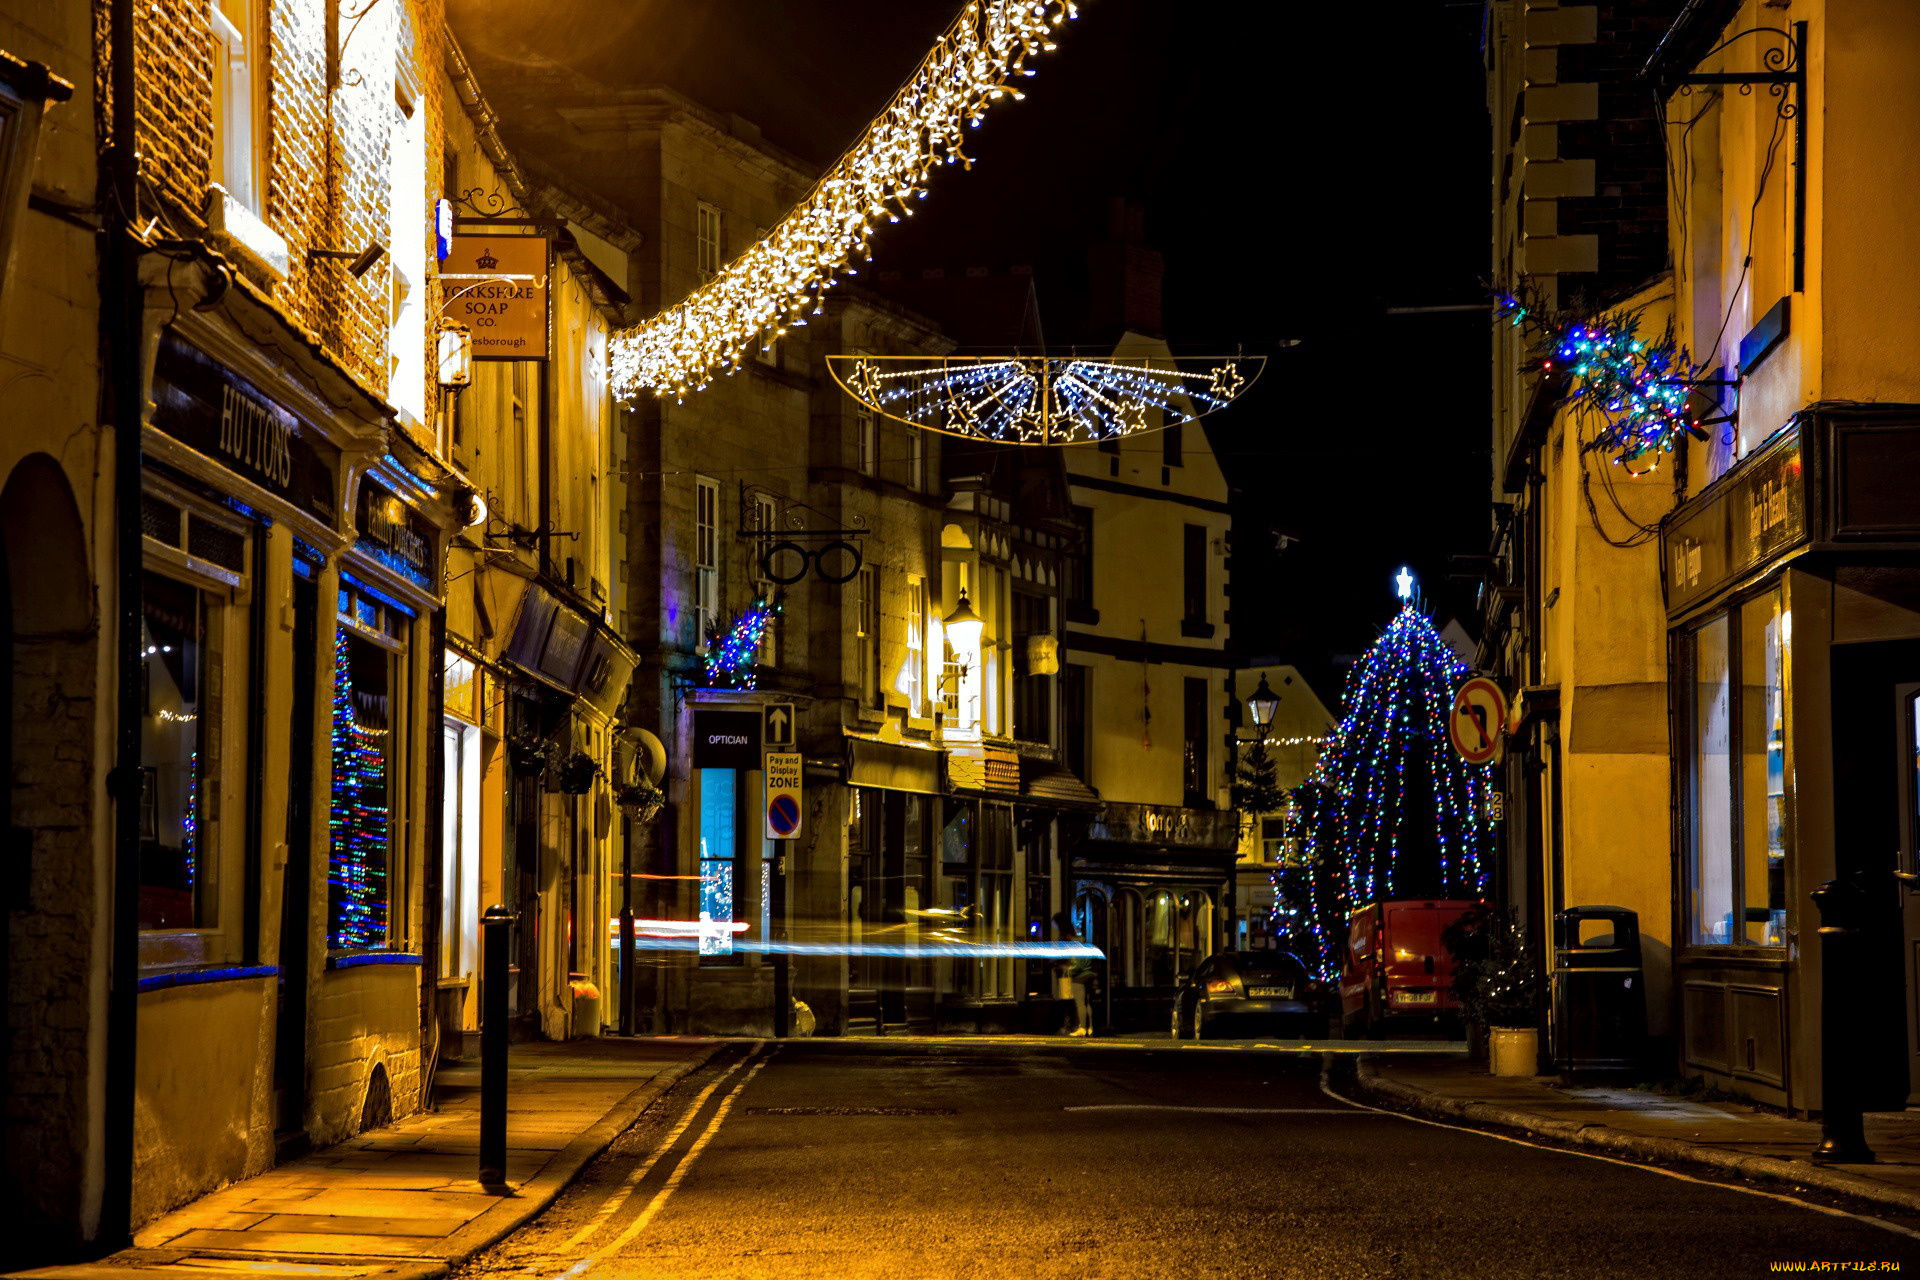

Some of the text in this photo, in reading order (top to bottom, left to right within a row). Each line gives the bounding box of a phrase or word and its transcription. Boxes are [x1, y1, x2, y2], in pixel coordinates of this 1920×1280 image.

[442, 286, 534, 299] YORKSHIRE
[465, 302, 509, 314] SOAP
[476, 318, 497, 327] CO.
[219, 384, 292, 488] HUTTONS
[708, 735, 748, 745] OPTICIAN
[769, 756, 799, 766] Pay and
[770, 766, 798, 776] Display
[769, 777, 799, 788] ZONE
